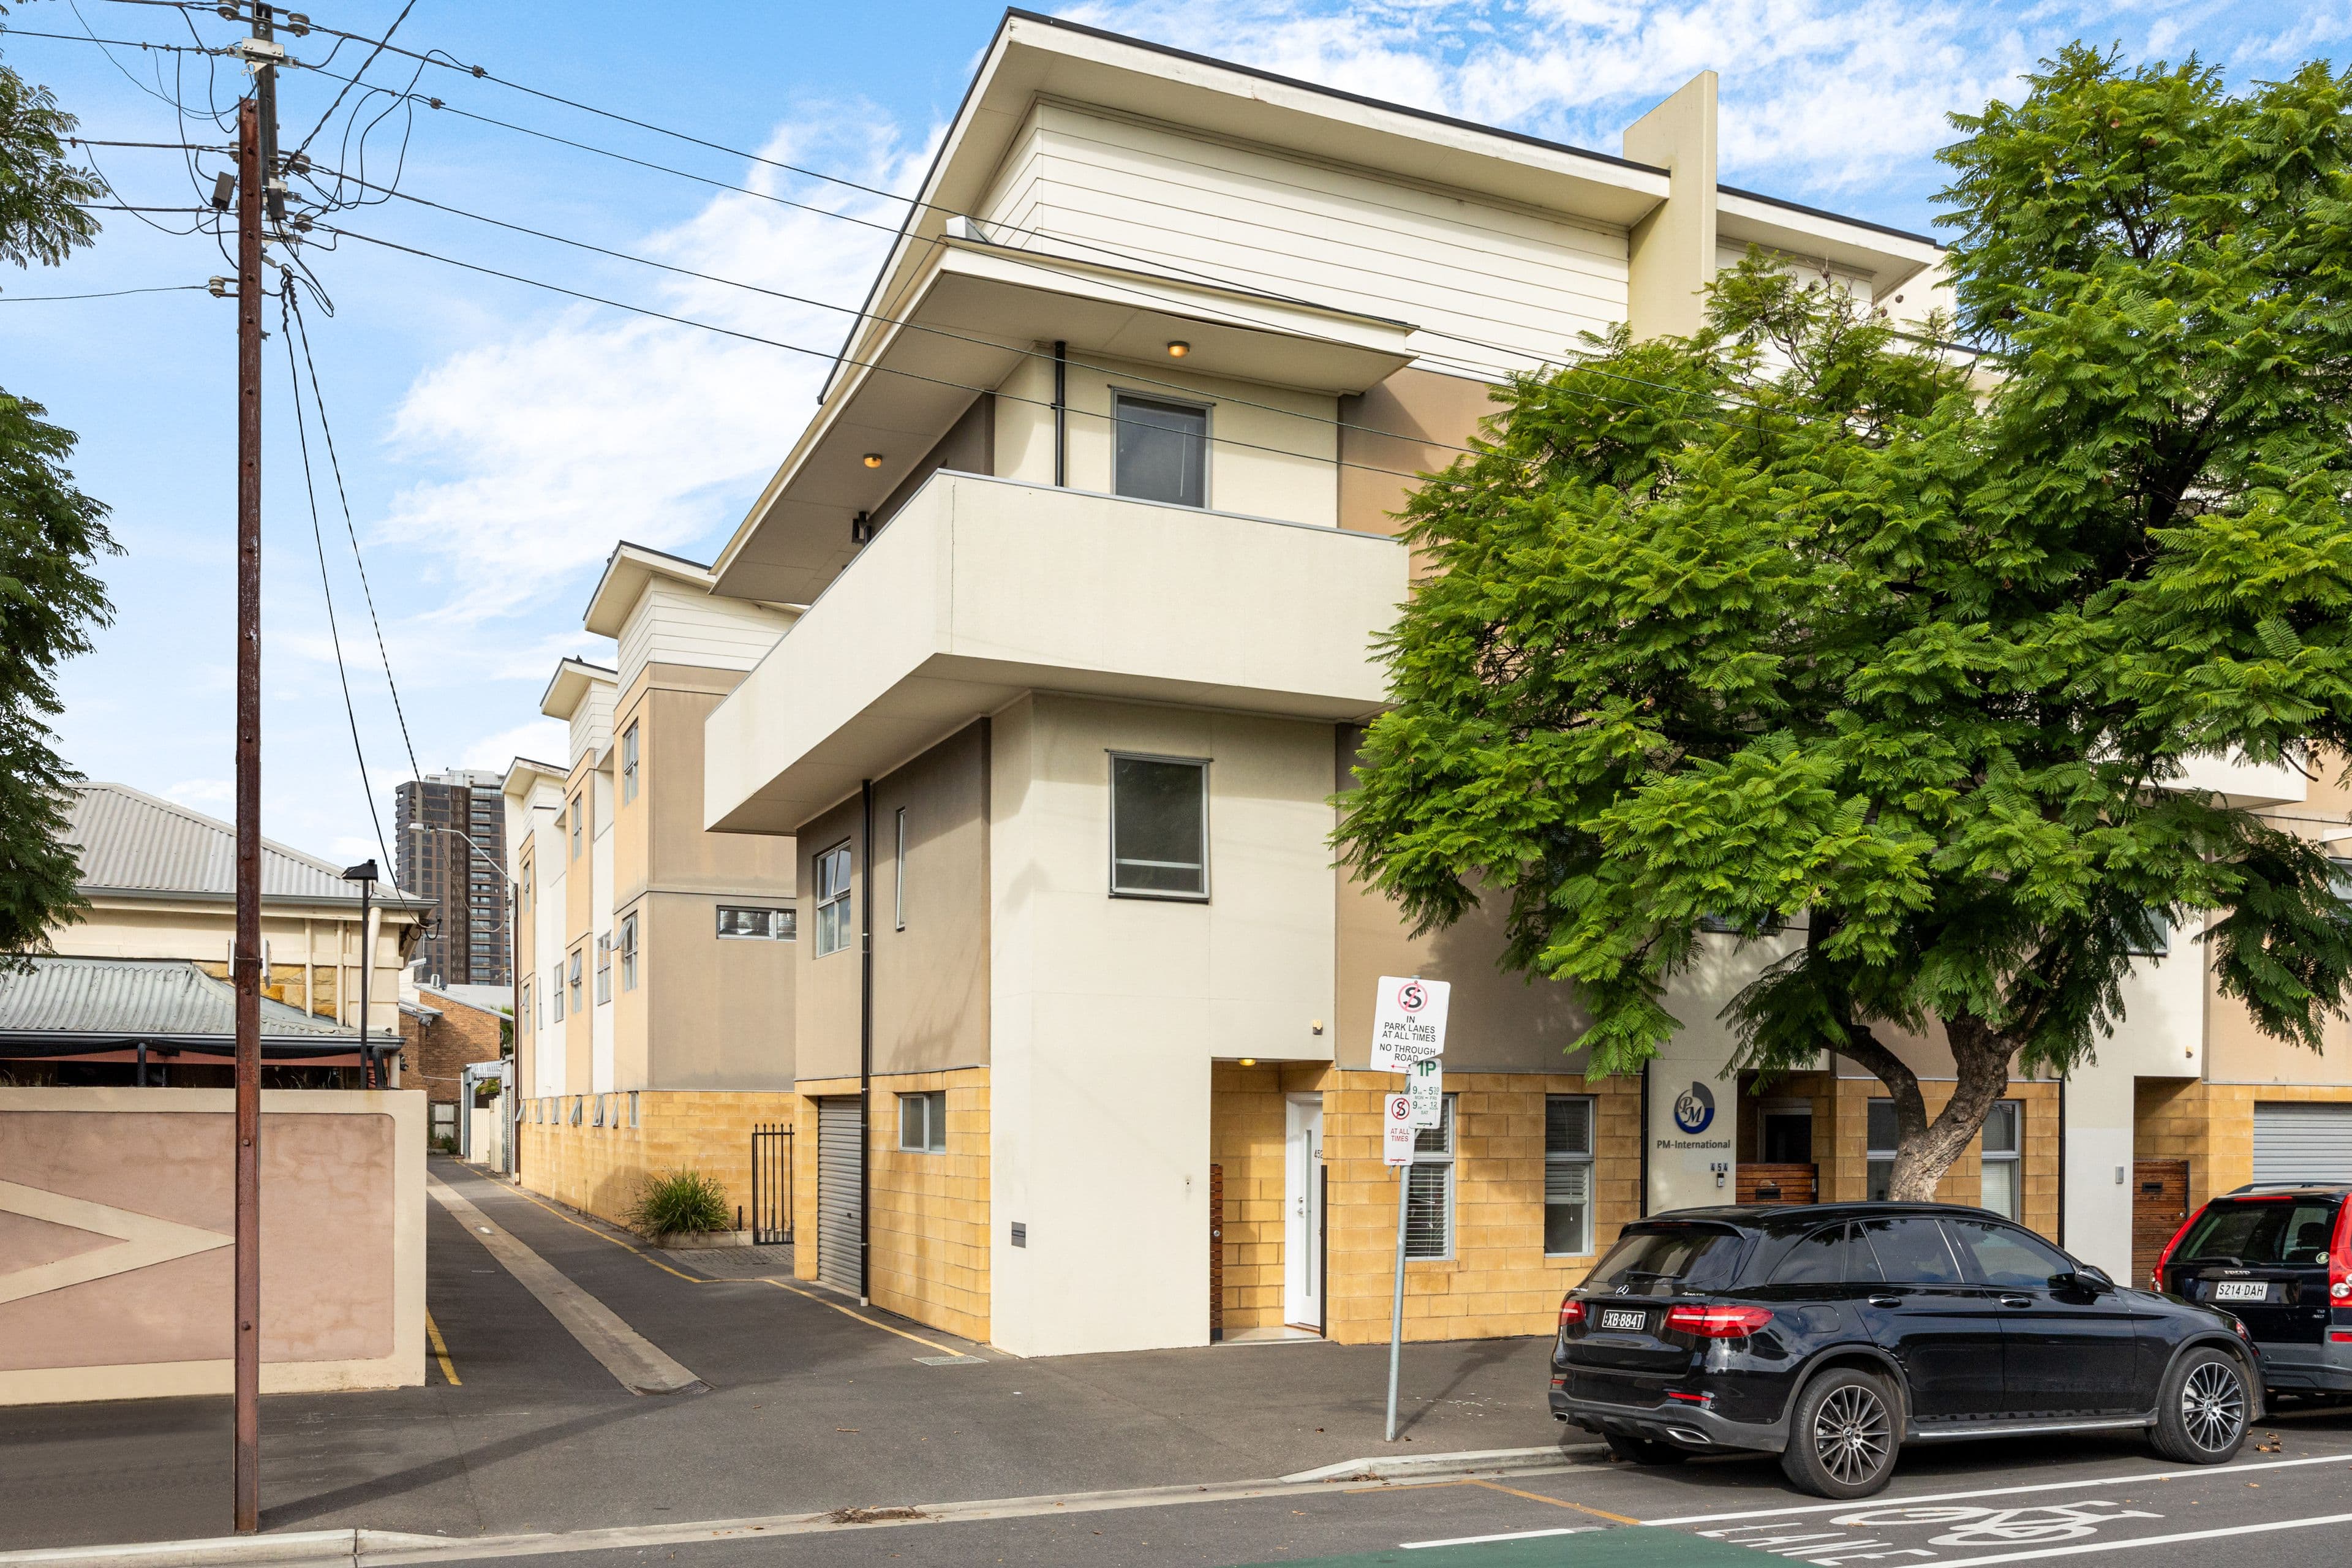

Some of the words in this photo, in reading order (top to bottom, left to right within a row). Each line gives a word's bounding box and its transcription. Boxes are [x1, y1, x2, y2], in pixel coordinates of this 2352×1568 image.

[1384, 1022, 1406, 1031] PARK
[1409, 1024, 1435, 1034] LANES
[1394, 1031, 1409, 1040] ALL
[1412, 1033, 1436, 1042] TIMES
[1394, 1044, 1436, 1055] THROUGH
[1394, 1053, 1419, 1062] ROAD
[1417, 1060, 1436, 1077] 1P
[1657, 1140, 1730, 1149] PM-International
[1710, 1163, 1728, 1172] 454
[1695, 1523, 1938, 1567] LANE
